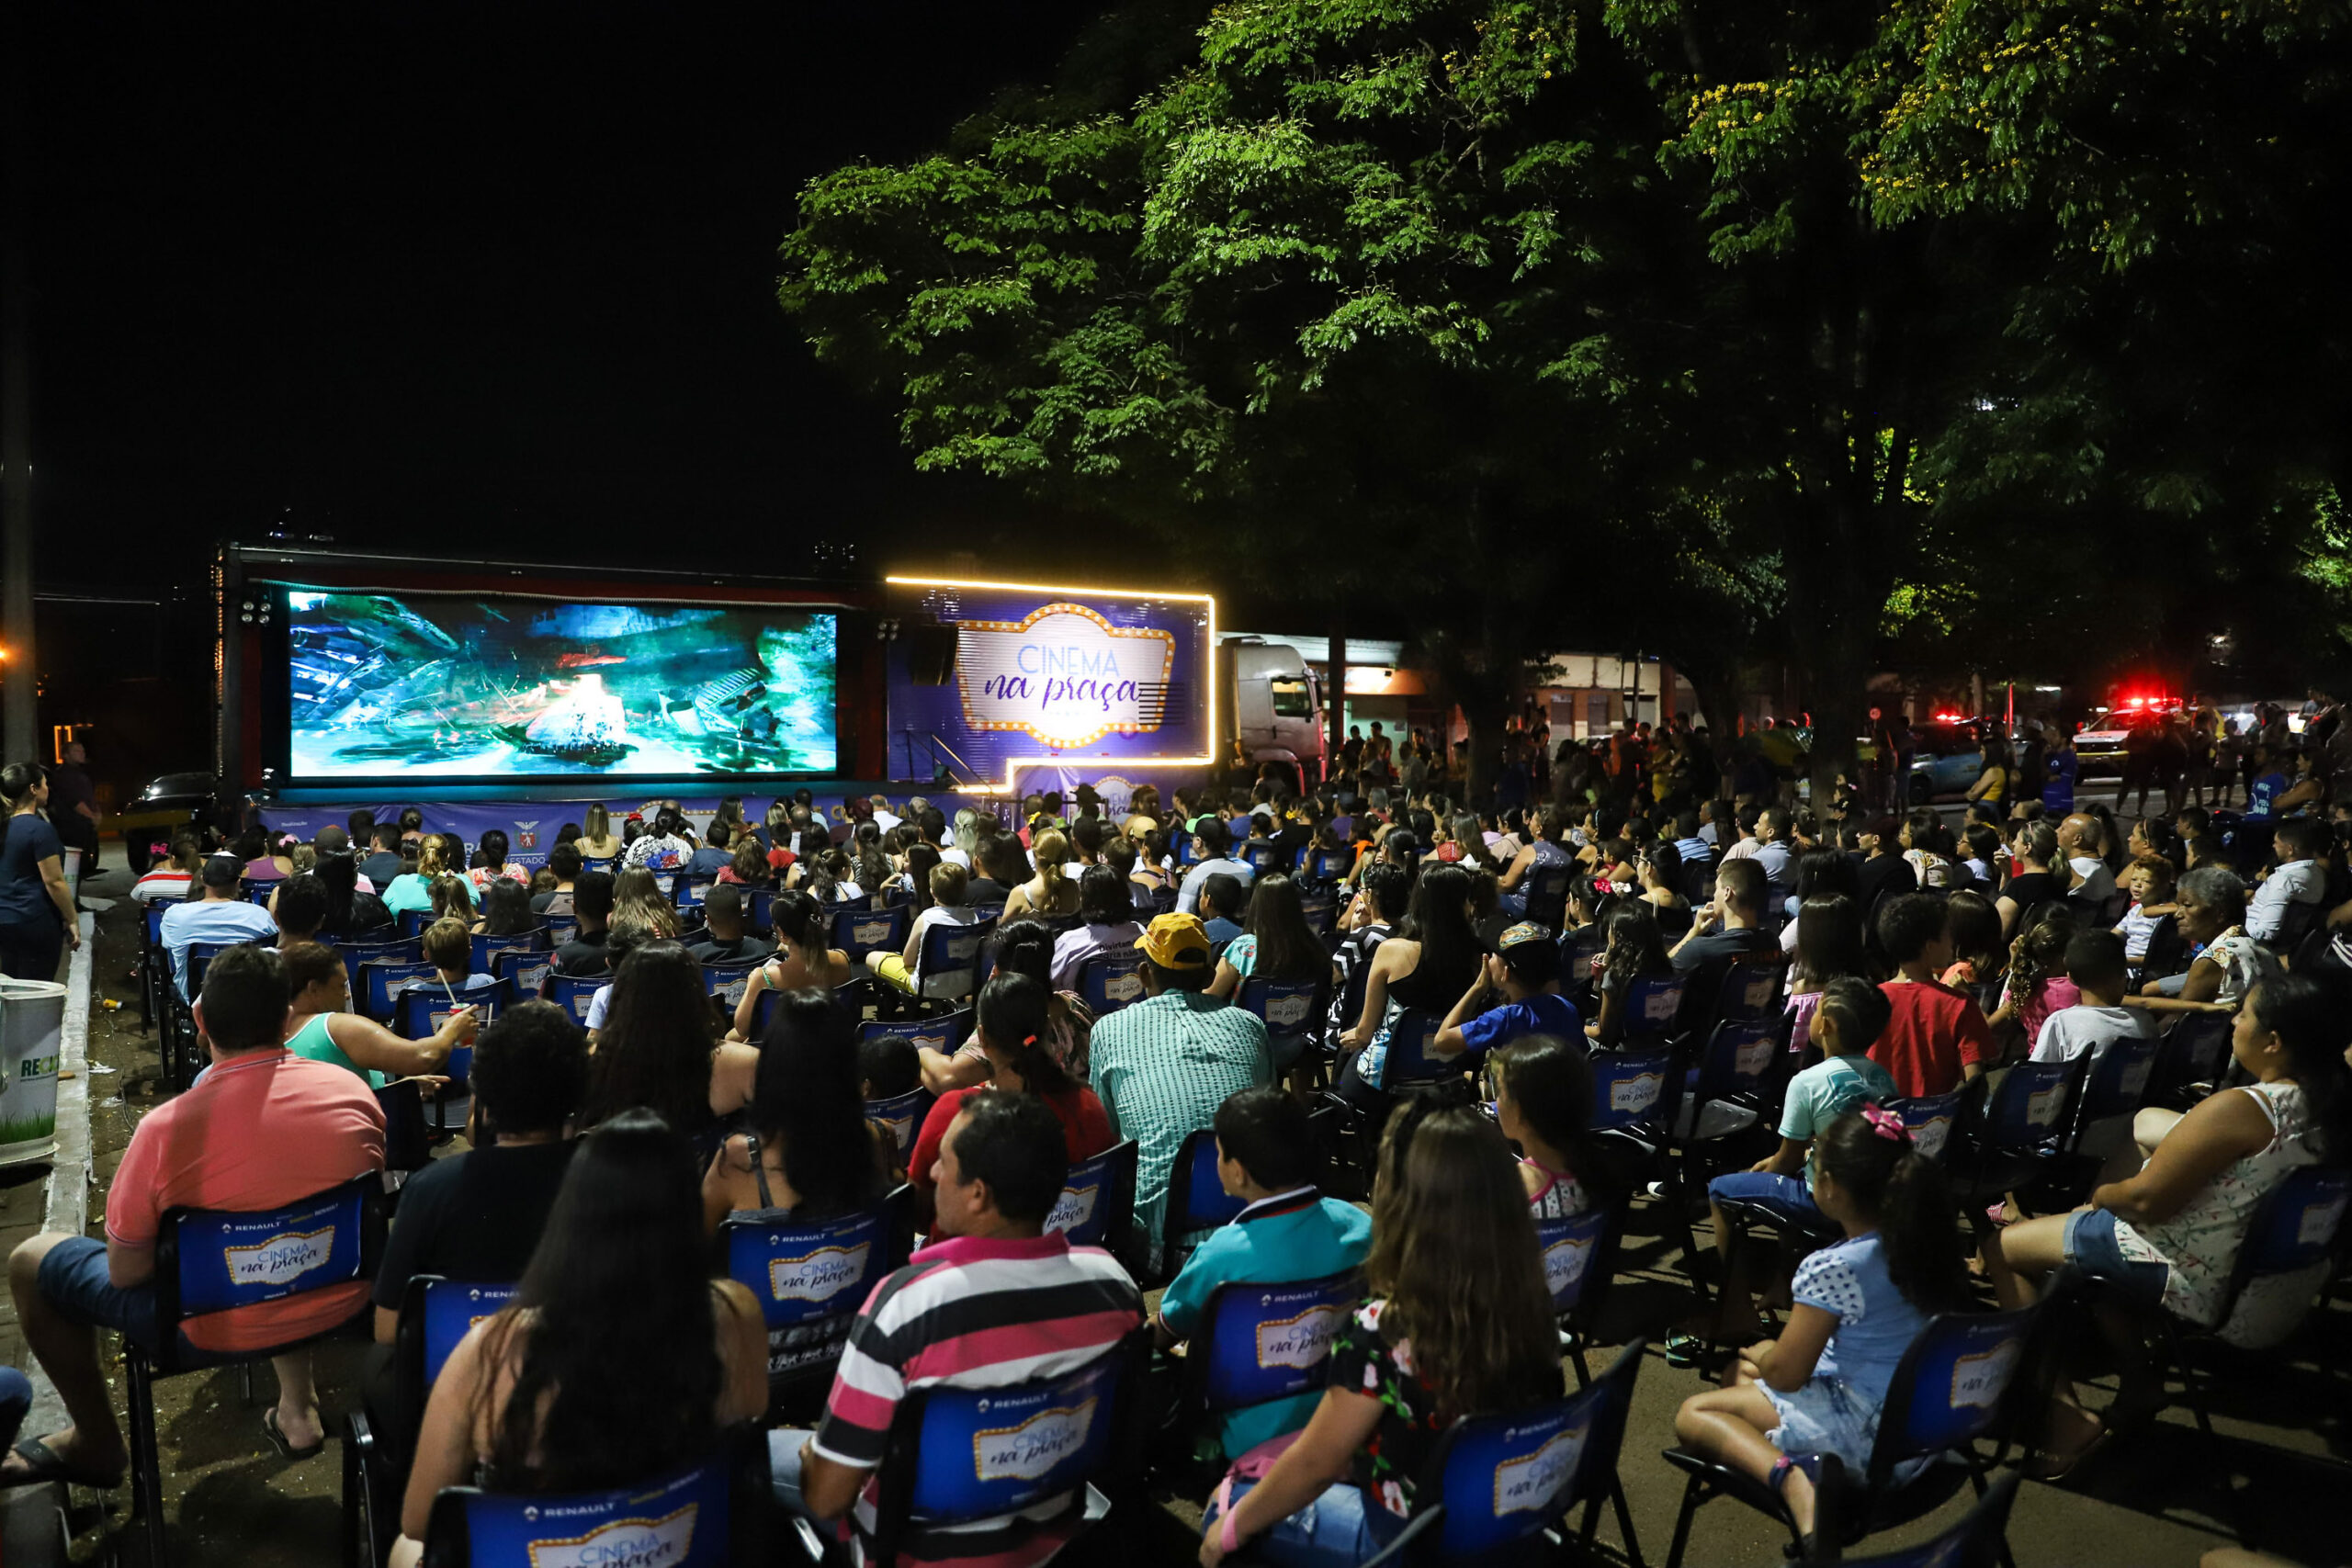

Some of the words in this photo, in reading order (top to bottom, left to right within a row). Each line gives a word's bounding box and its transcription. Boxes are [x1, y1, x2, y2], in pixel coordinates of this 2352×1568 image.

[1017, 643, 1120, 677] CINEMA
[984, 674, 1035, 699] na
[1043, 676, 1143, 711] praça
[510, 856, 546, 864] ESTADO
[235, 1220, 281, 1232] RENAULT
[1046, 1206, 1084, 1227] praça
[783, 1233, 827, 1243] RENAULT
[241, 1263, 266, 1273] na
[270, 1249, 317, 1274] praça
[257, 1243, 309, 1263] CINEMA
[800, 1258, 847, 1277] CINEMA
[783, 1276, 807, 1288] na
[809, 1265, 855, 1290] praça
[483, 1291, 521, 1299] RENA
[1273, 1291, 1319, 1303] RENAULT
[1270, 1339, 1293, 1353] na
[993, 1393, 1049, 1409] RENAULT
[990, 1451, 1018, 1465] na
[1023, 1429, 1078, 1464] praça
[544, 1502, 616, 1517] RENAULT
[580, 1533, 660, 1563] CINEMA
